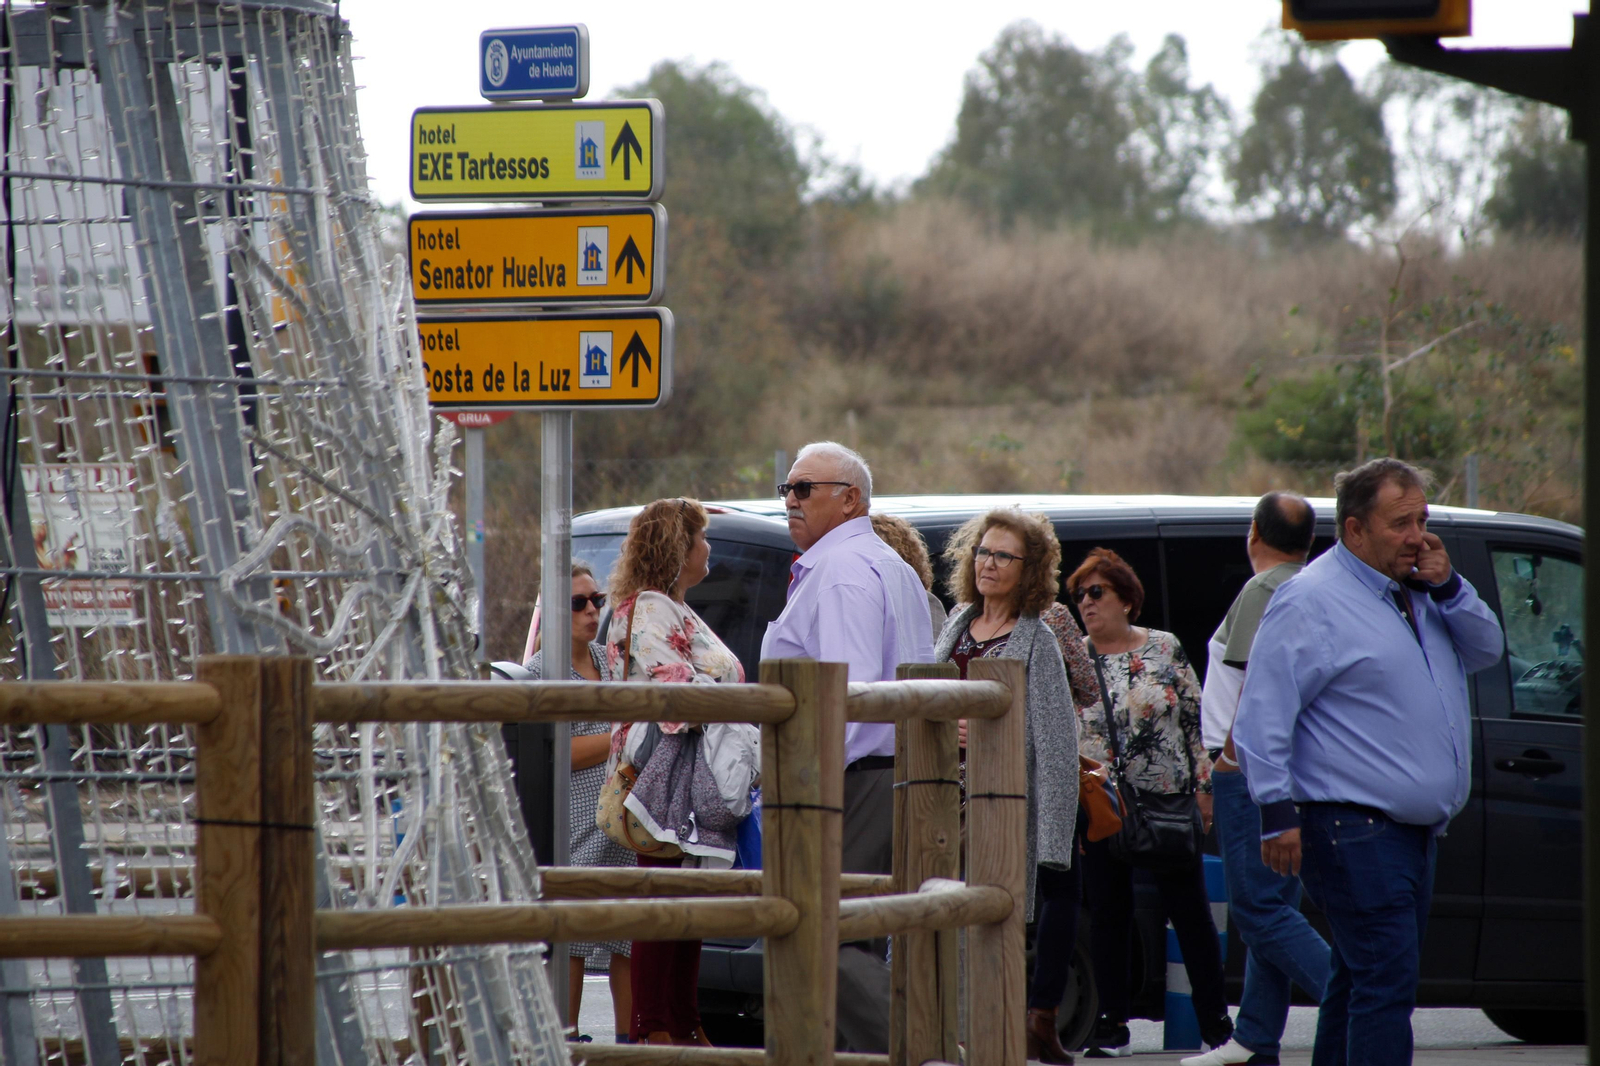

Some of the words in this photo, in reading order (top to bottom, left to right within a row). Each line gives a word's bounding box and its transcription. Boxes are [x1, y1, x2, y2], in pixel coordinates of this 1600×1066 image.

[510, 43, 574, 60] Ayuntamiento
[529, 63, 540, 78] de
[542, 61, 574, 77] Huelva
[419, 123, 456, 145] hotel
[418, 152, 453, 181] EXE
[457, 151, 550, 180] Tartessos
[418, 227, 460, 250] hotel
[419, 258, 494, 290] Senator
[503, 256, 566, 288] Huelva
[418, 328, 460, 351] hotel
[483, 363, 505, 391] de
[513, 361, 530, 392] la
[539, 361, 571, 391] Luz
[458, 412, 490, 424] GRUA
